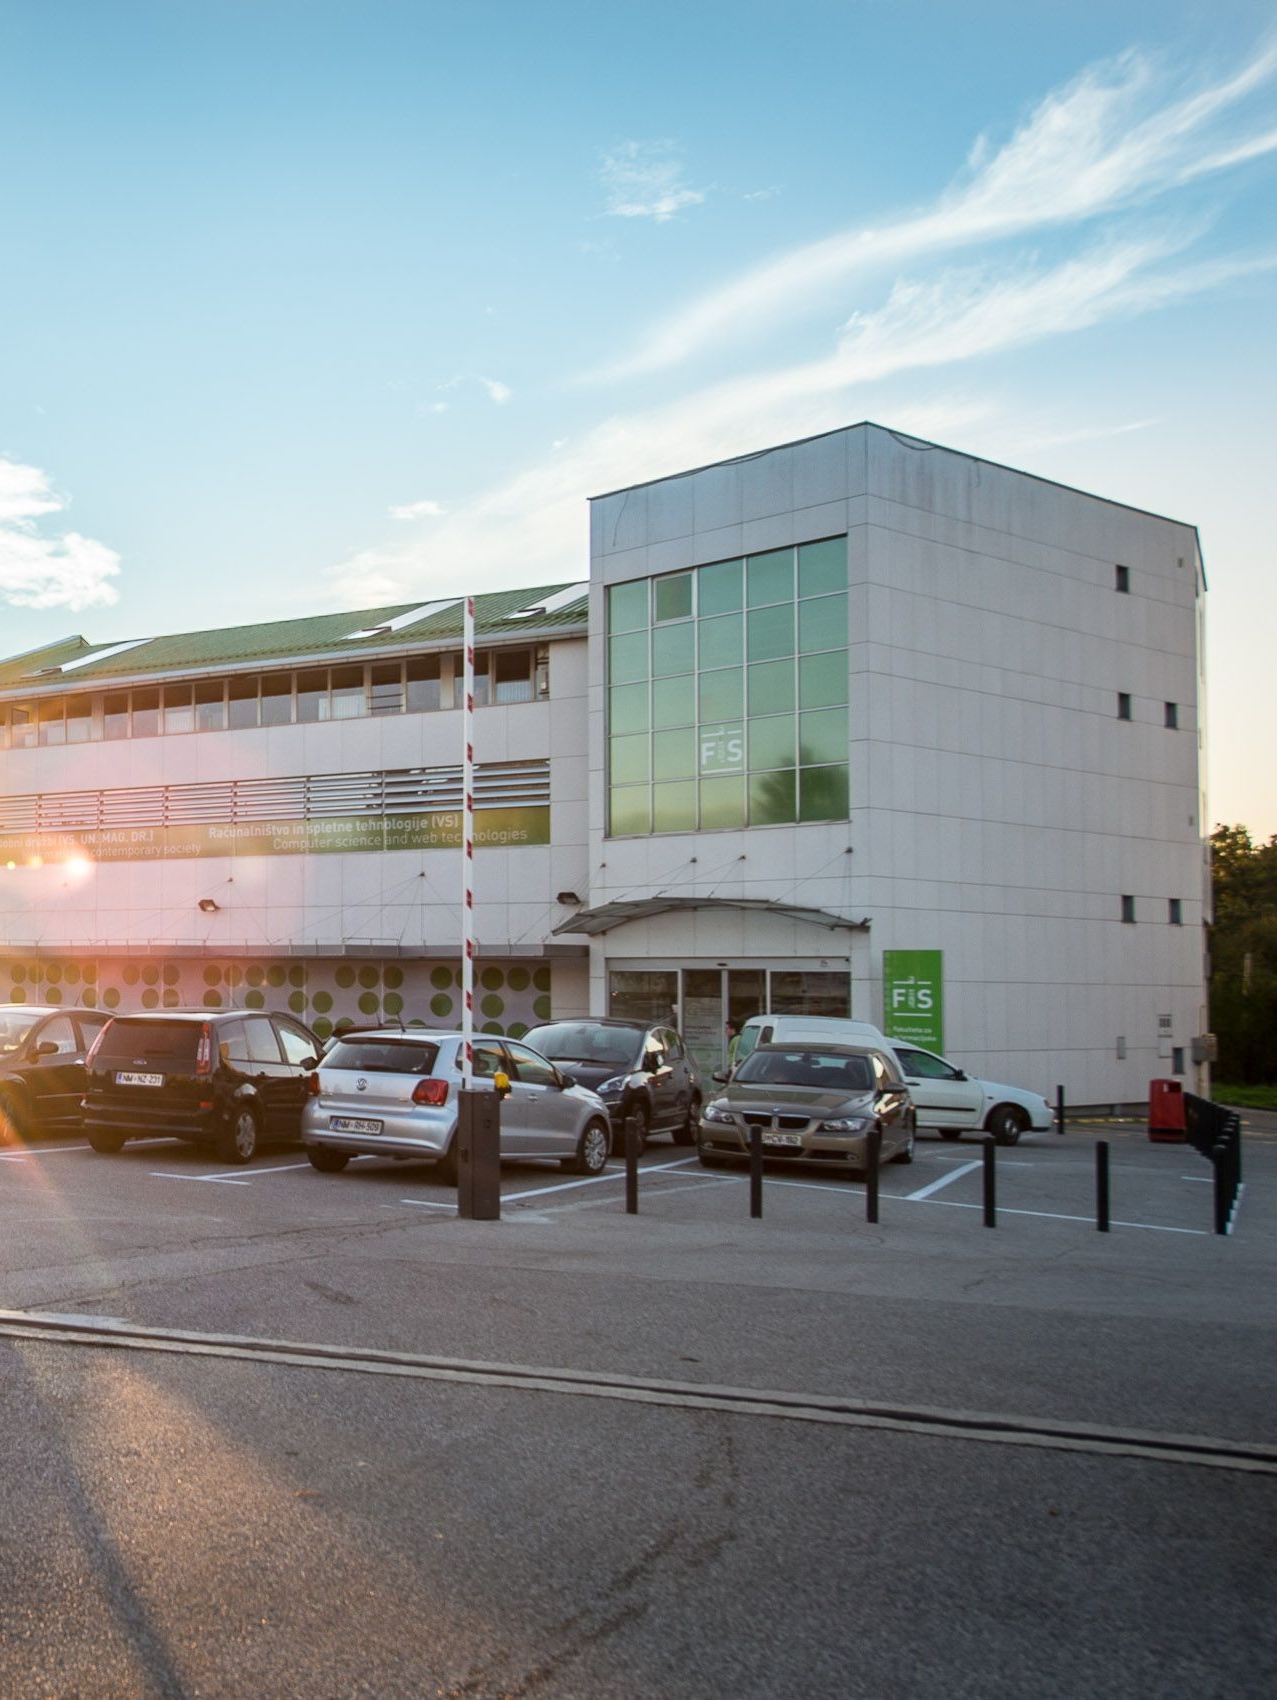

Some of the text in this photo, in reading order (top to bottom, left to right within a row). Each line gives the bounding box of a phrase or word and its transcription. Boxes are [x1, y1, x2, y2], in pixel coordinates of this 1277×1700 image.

[306, 820, 353, 837] spletne
[355, 816, 428, 834] tehnologije
[273, 828, 528, 852] Computer science and web tecnologies
